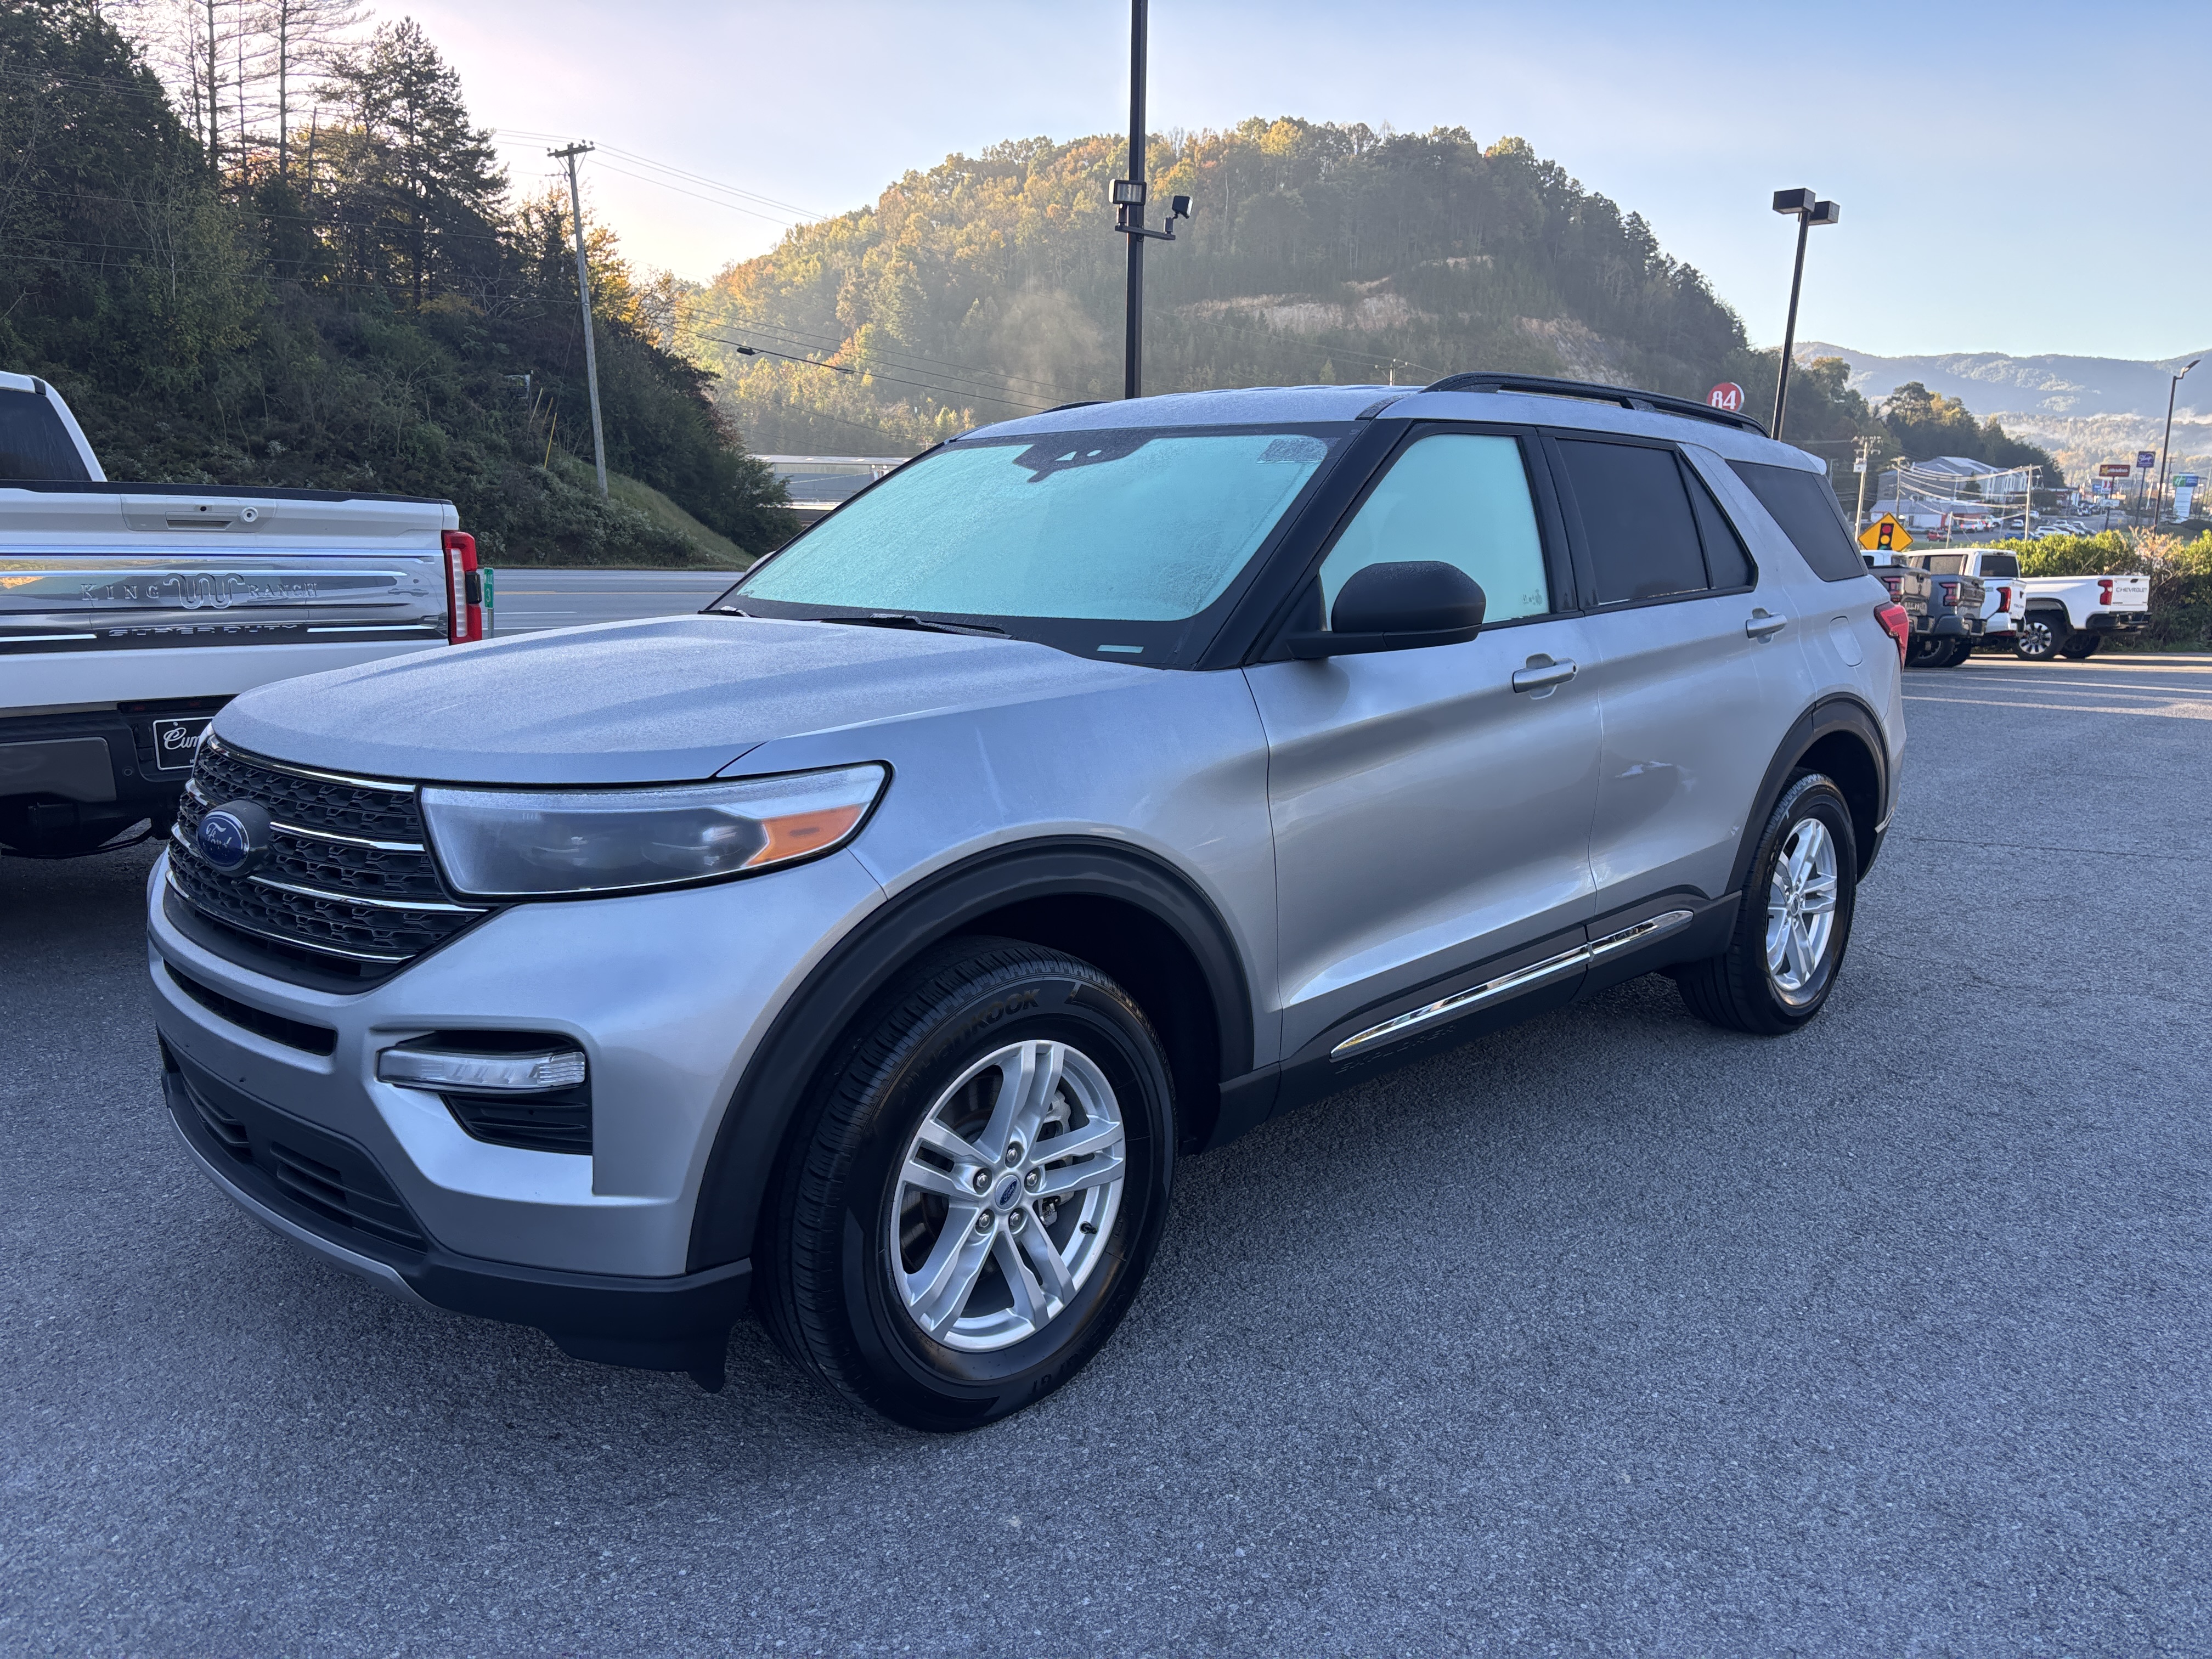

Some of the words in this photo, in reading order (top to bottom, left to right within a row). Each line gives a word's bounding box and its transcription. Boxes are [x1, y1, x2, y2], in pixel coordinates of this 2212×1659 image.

[1712, 390, 1736, 410] 84
[80, 583, 160, 601] KING
[247, 582, 318, 598] RANCH
[205, 822, 233, 847] Ford
